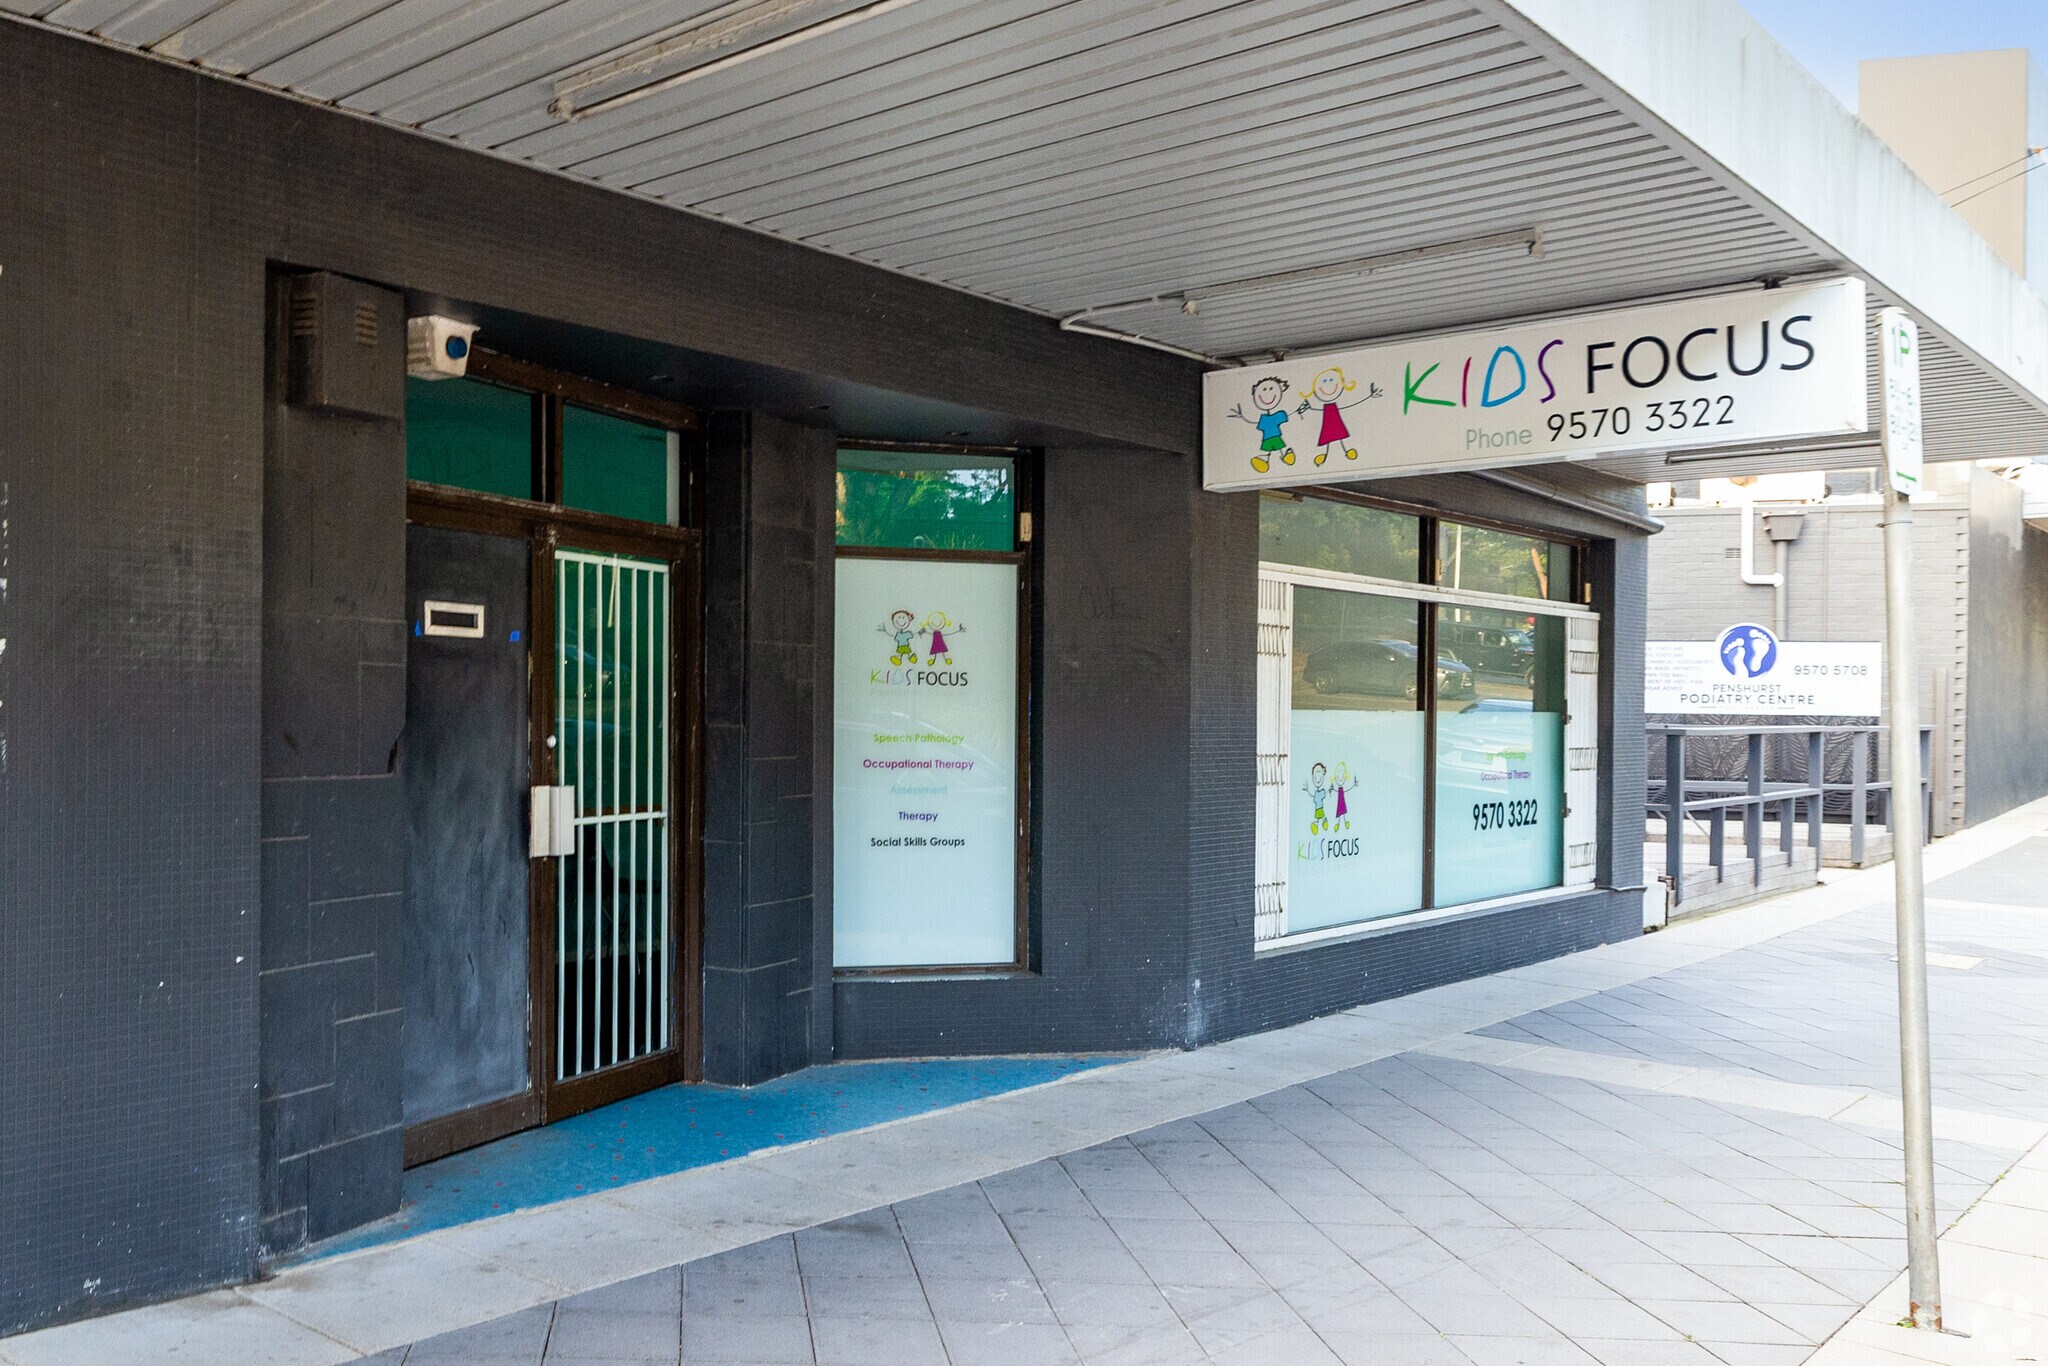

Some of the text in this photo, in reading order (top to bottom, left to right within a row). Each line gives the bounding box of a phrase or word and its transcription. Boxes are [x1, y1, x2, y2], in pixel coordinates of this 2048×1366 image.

[1403, 315, 1814, 415] KIDS FOCUS
[1465, 394, 1735, 450] Phone 9570 3322
[1794, 665, 1868, 676] 9570 5708
[870, 668, 969, 687] KIDS FOCUS
[1713, 684, 1782, 693] PENSHURST
[1680, 693, 1815, 705] PODIATRY CENTRE
[873, 733, 964, 746] Speech Pathology
[863, 759, 974, 771] Occupational Therapy
[890, 785, 948, 795] Assessment
[898, 811, 938, 822] Therapy
[1472, 798, 1538, 831] 9570 3322
[870, 837, 966, 848] Social Skills Groups
[1297, 837, 1360, 861] KIDS FOCUS
